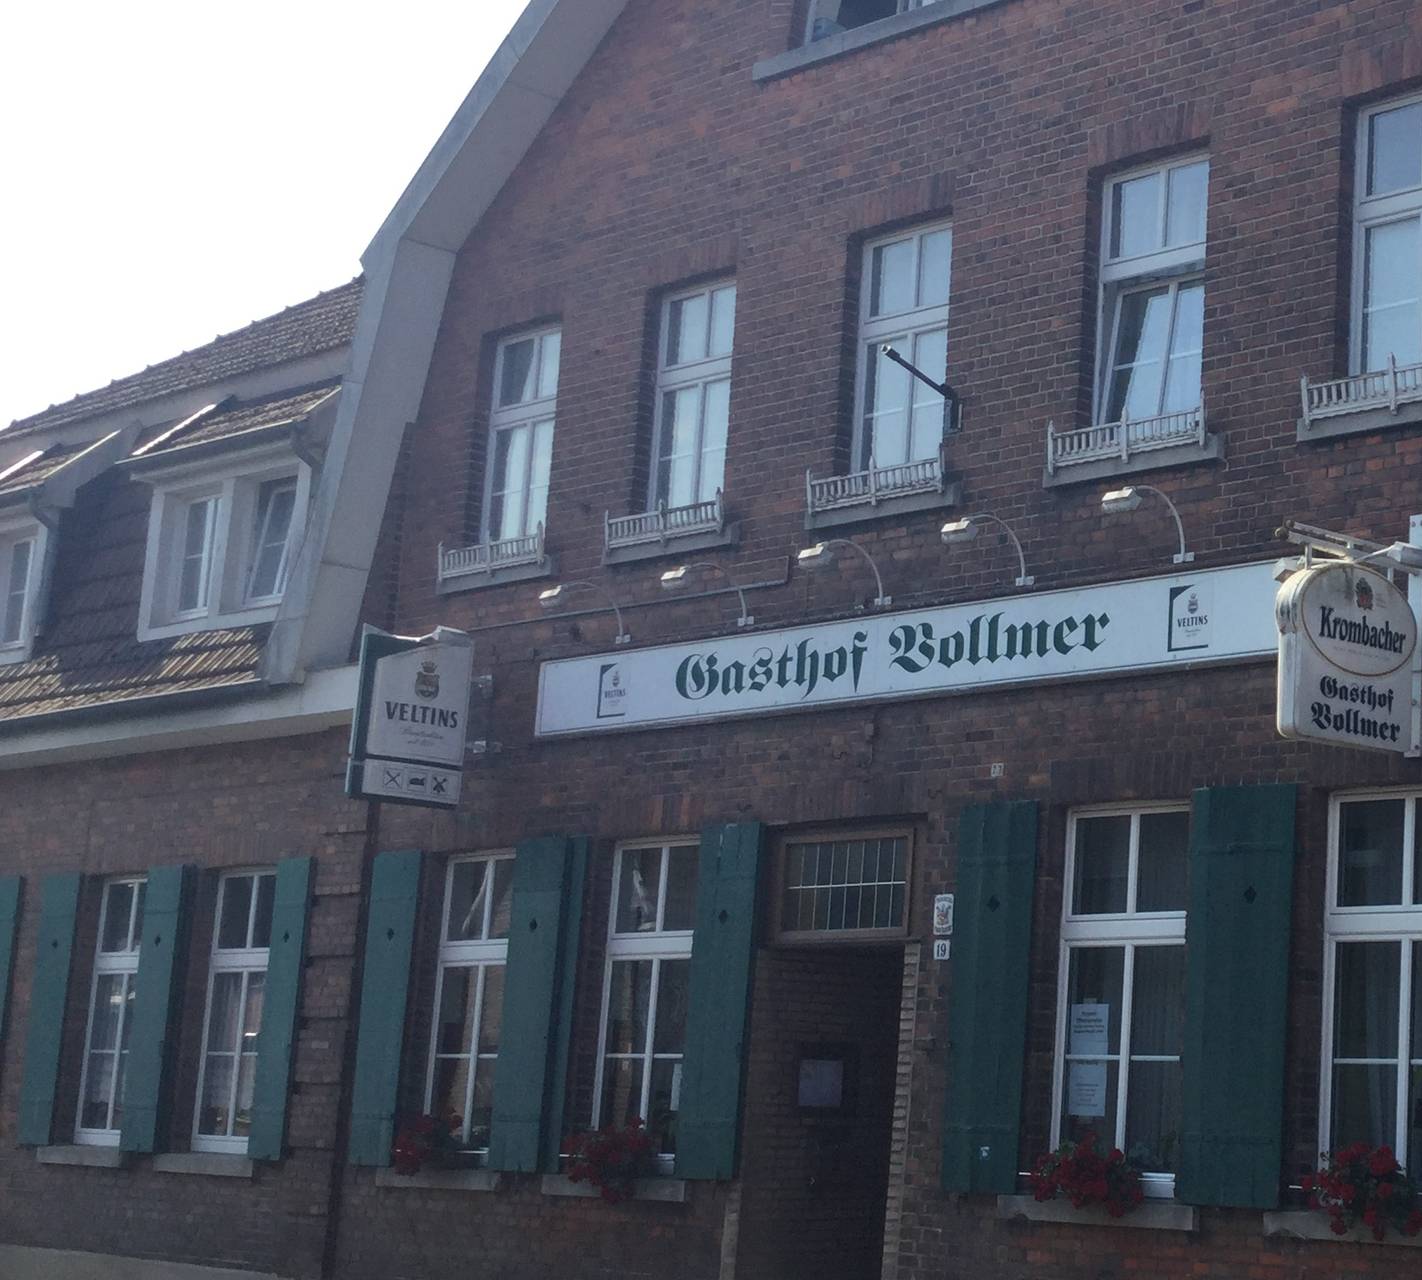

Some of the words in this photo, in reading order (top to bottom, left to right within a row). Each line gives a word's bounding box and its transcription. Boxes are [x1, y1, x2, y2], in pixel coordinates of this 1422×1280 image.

[1177, 615, 1208, 628] VELTINS
[1318, 605, 1407, 654] Krombacher
[675, 631, 868, 700] Gasthof
[888, 611, 1111, 673] Vollmer
[1319, 675, 1395, 714] Gasthof
[384, 700, 458, 729] VELTINS
[1310, 702, 1401, 743] Vollmer
[936, 943, 947, 958] 19
